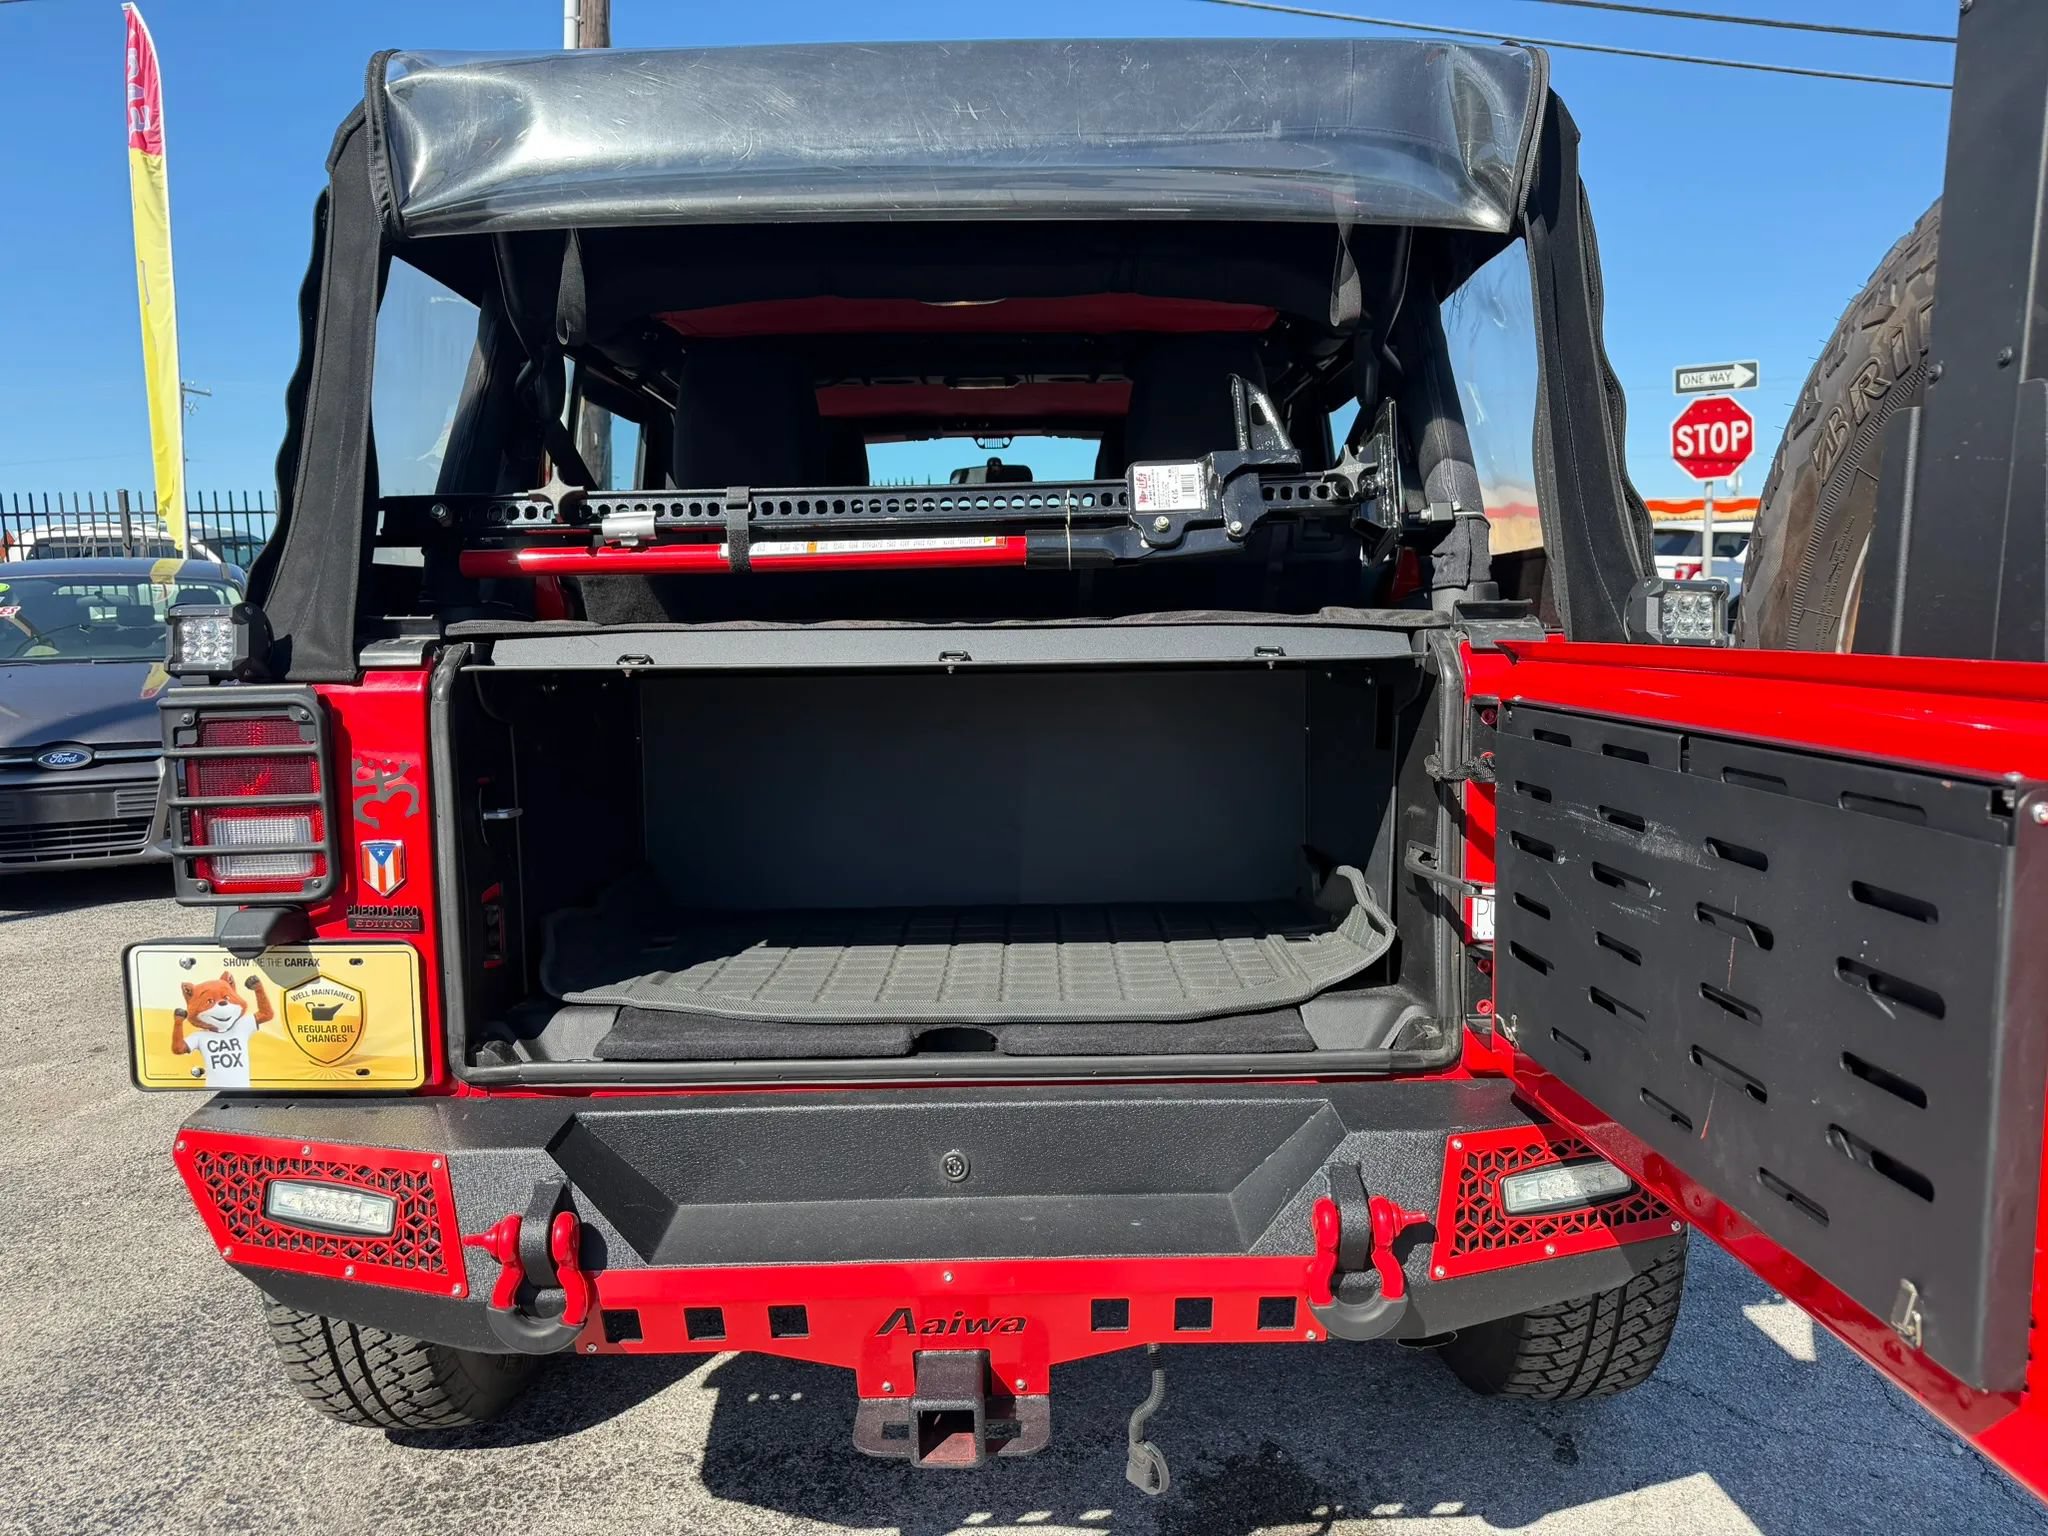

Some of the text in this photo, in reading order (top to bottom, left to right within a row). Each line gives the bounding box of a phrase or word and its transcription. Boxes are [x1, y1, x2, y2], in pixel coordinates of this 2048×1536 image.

[1682, 371, 1732, 386] ONE WAY
[1676, 420, 1749, 457] STOP
[49, 752, 78, 764] Ford
[346, 905, 418, 916] PUERTO RICO
[355, 920, 412, 928] EDITION
[223, 957, 250, 967] SHOW
[267, 957, 282, 968] THE
[284, 958, 320, 967] CARFAX
[290, 988, 355, 1002] WELL MAINTAINED
[297, 1024, 355, 1033] REGULAR OIL
[306, 1034, 348, 1043] CHANGES
[206, 1038, 242, 1053] CAR
[211, 1052, 243, 1069] FOX
[875, 1307, 1027, 1337] Aaiwa
